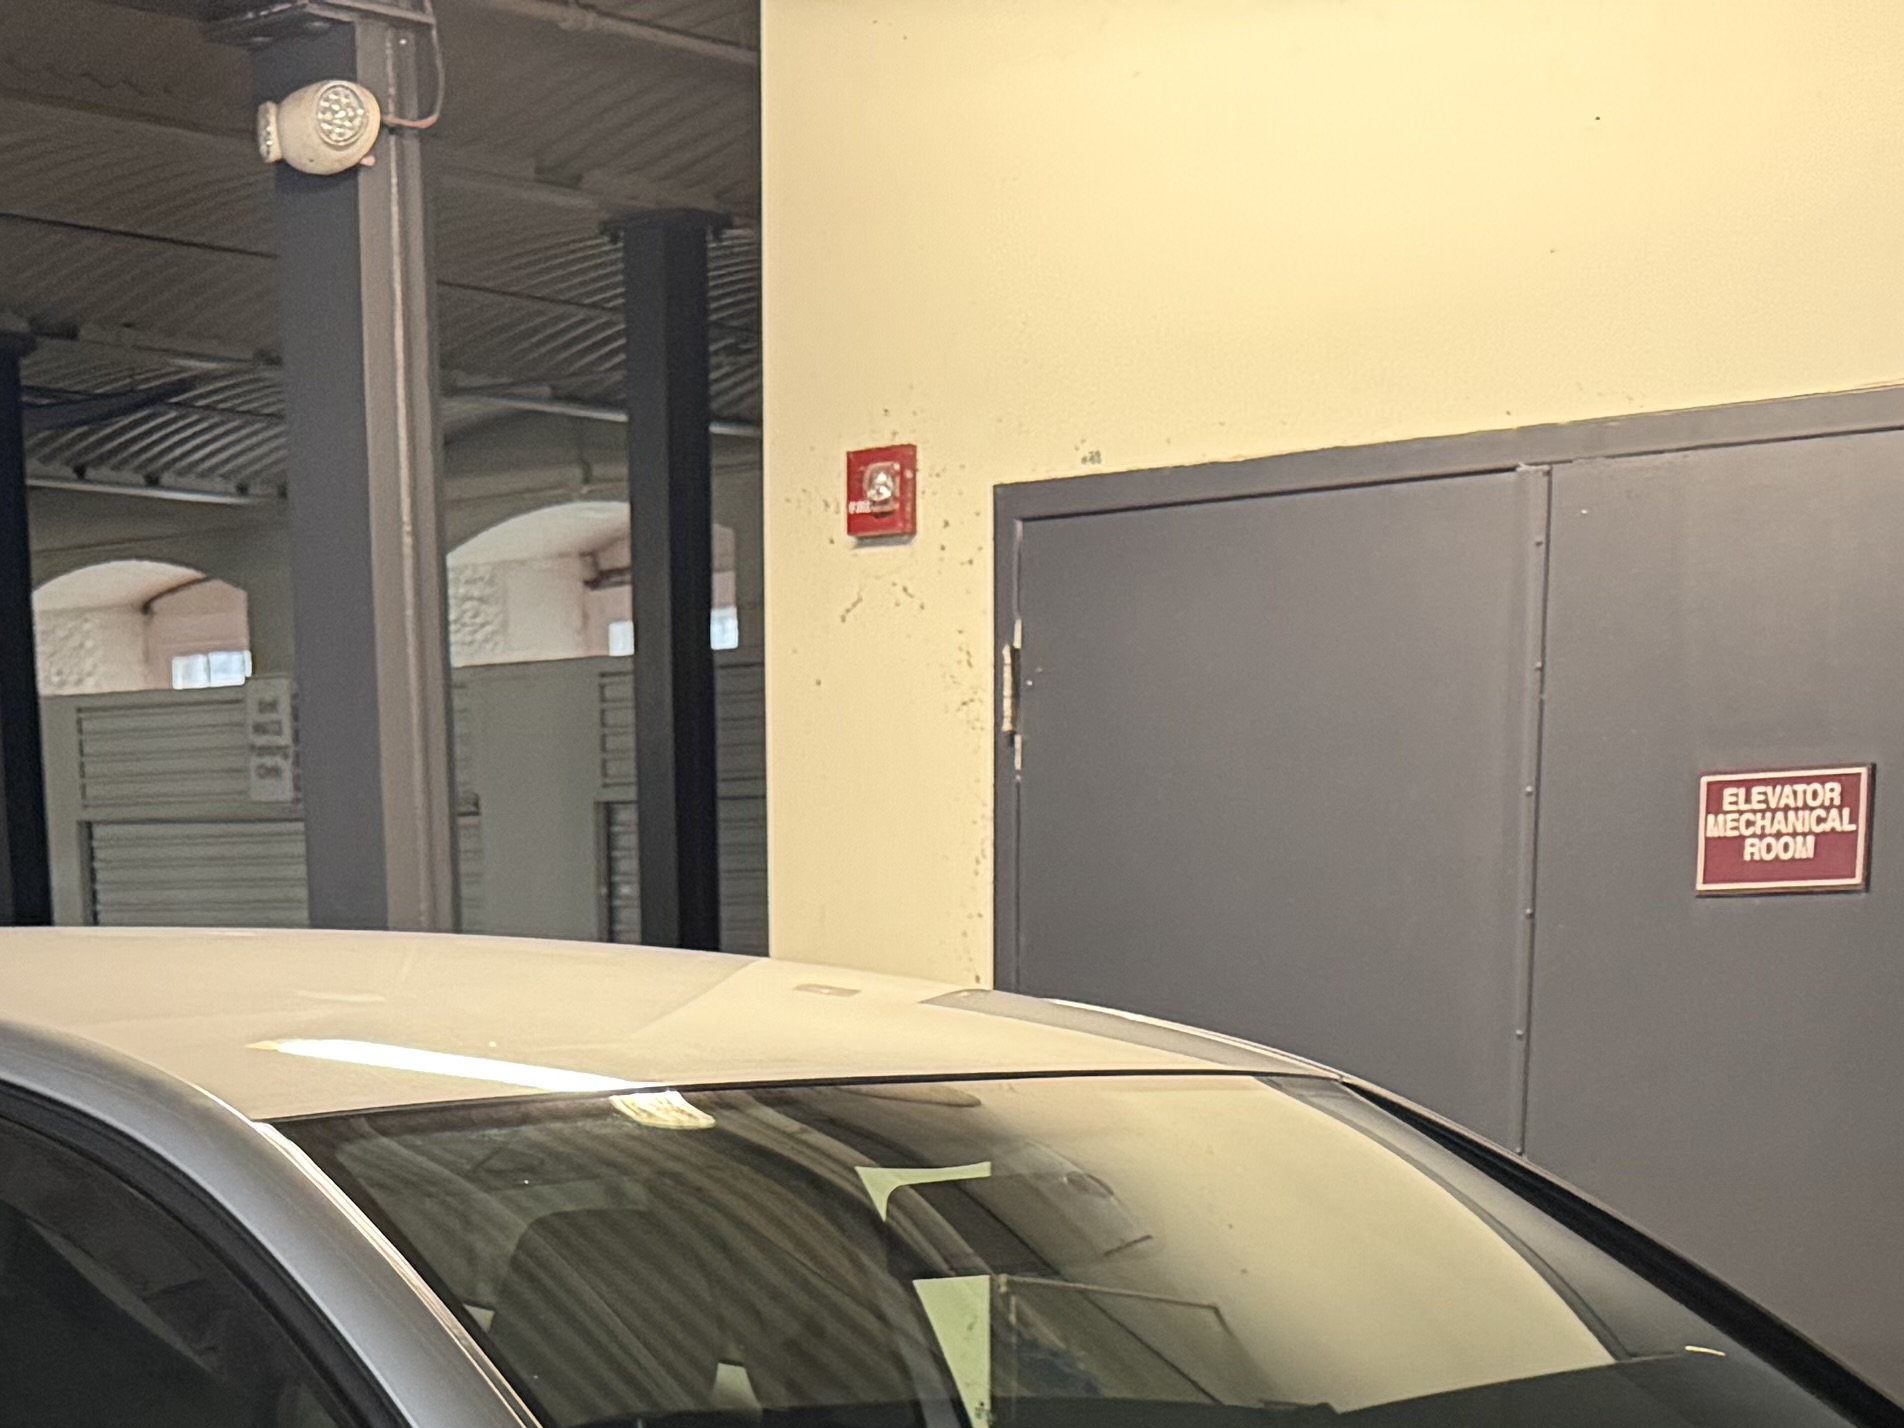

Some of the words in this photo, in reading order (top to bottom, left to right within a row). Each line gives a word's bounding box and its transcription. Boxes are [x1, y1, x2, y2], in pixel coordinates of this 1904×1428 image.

[1722, 782, 1842, 811] ELEVATOR
[1705, 807, 1857, 838] MECHANICAL
[1743, 834, 1816, 861] ROOM
